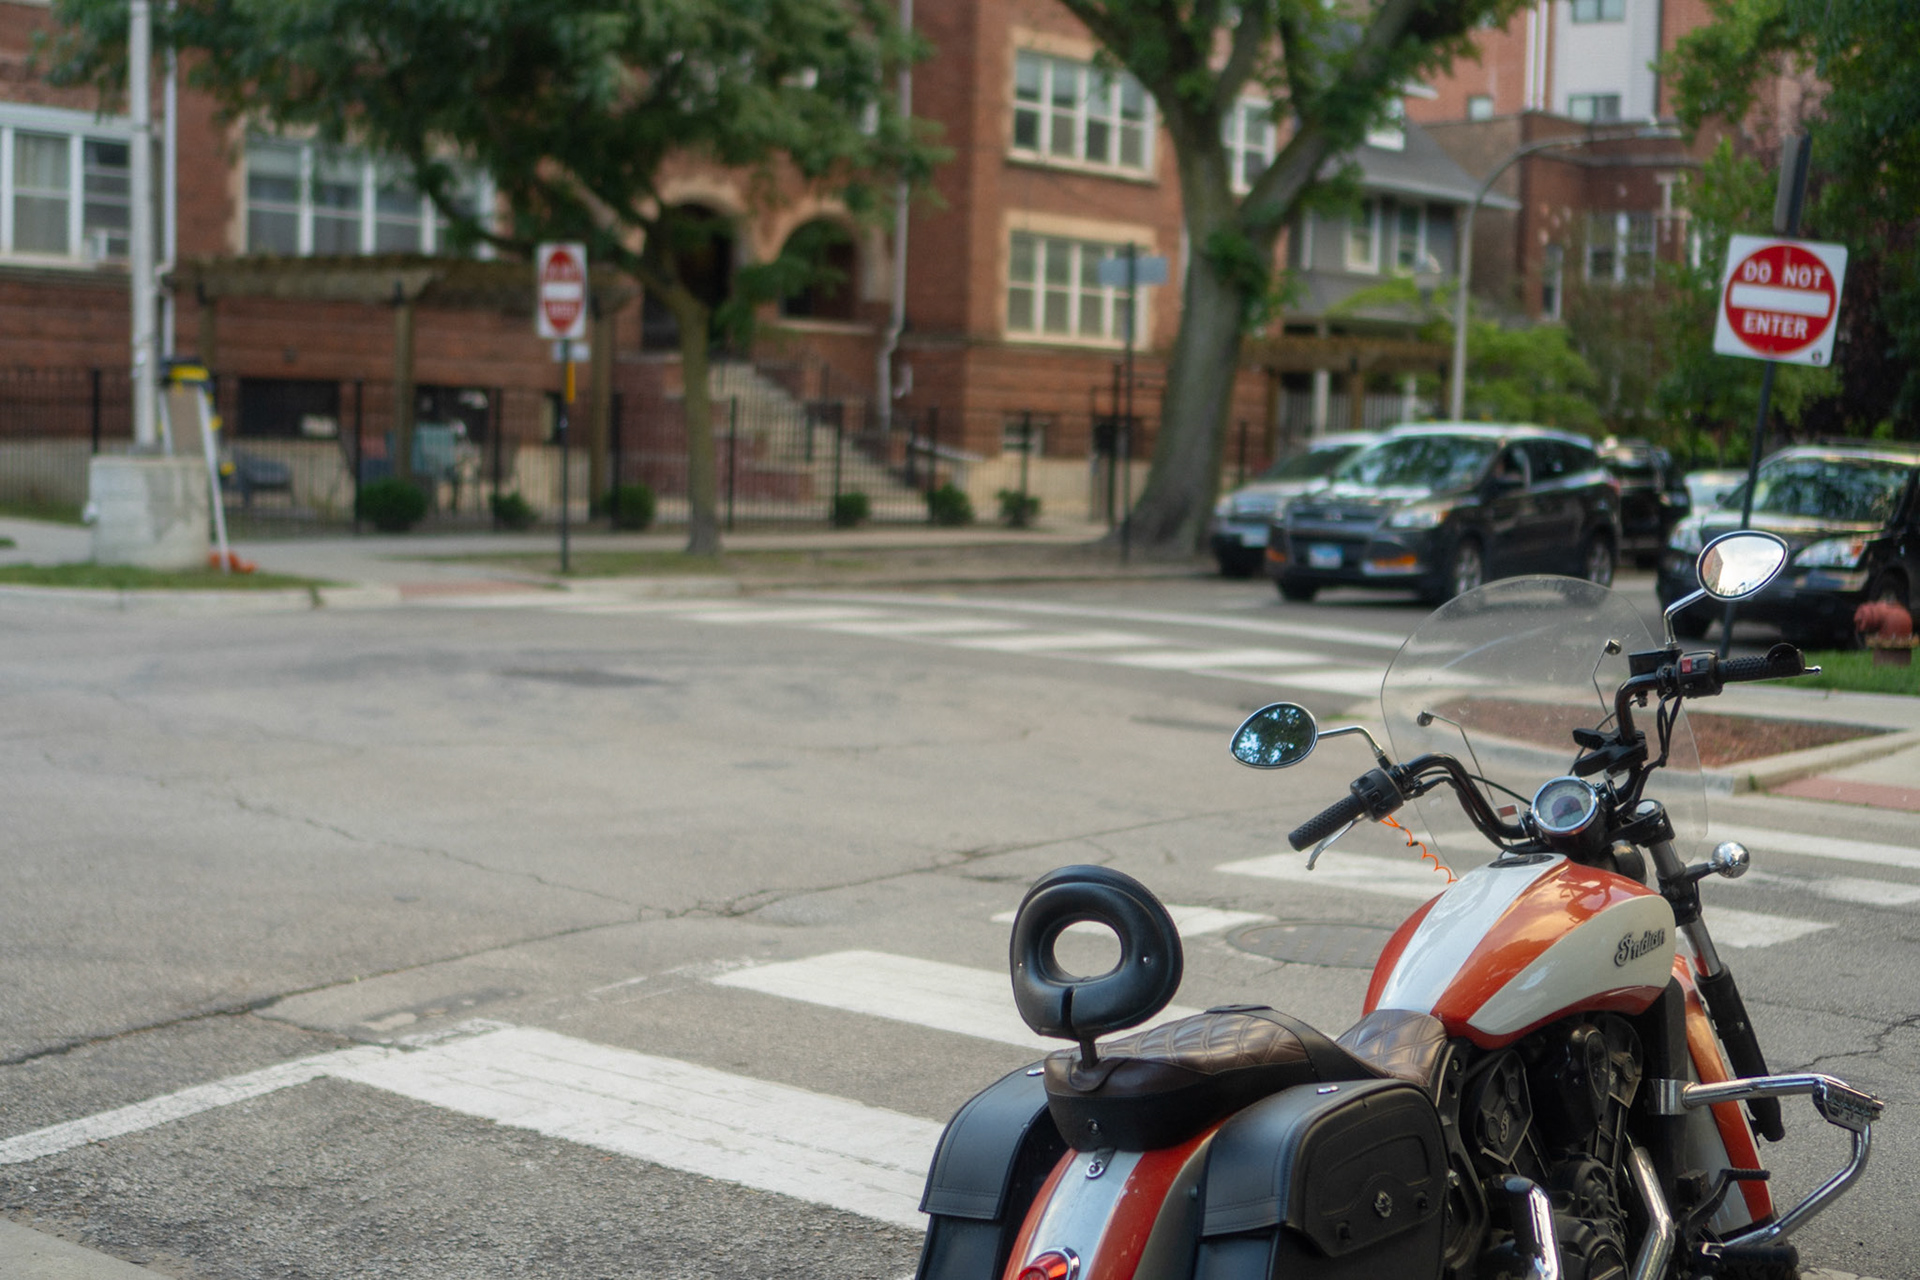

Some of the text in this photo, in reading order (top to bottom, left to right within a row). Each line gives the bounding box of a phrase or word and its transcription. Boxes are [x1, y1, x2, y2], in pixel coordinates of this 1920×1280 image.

[1743, 260, 1825, 289] DO NOT
[1743, 311, 1809, 340] ENTER
[1613, 928, 1666, 968] Indian
